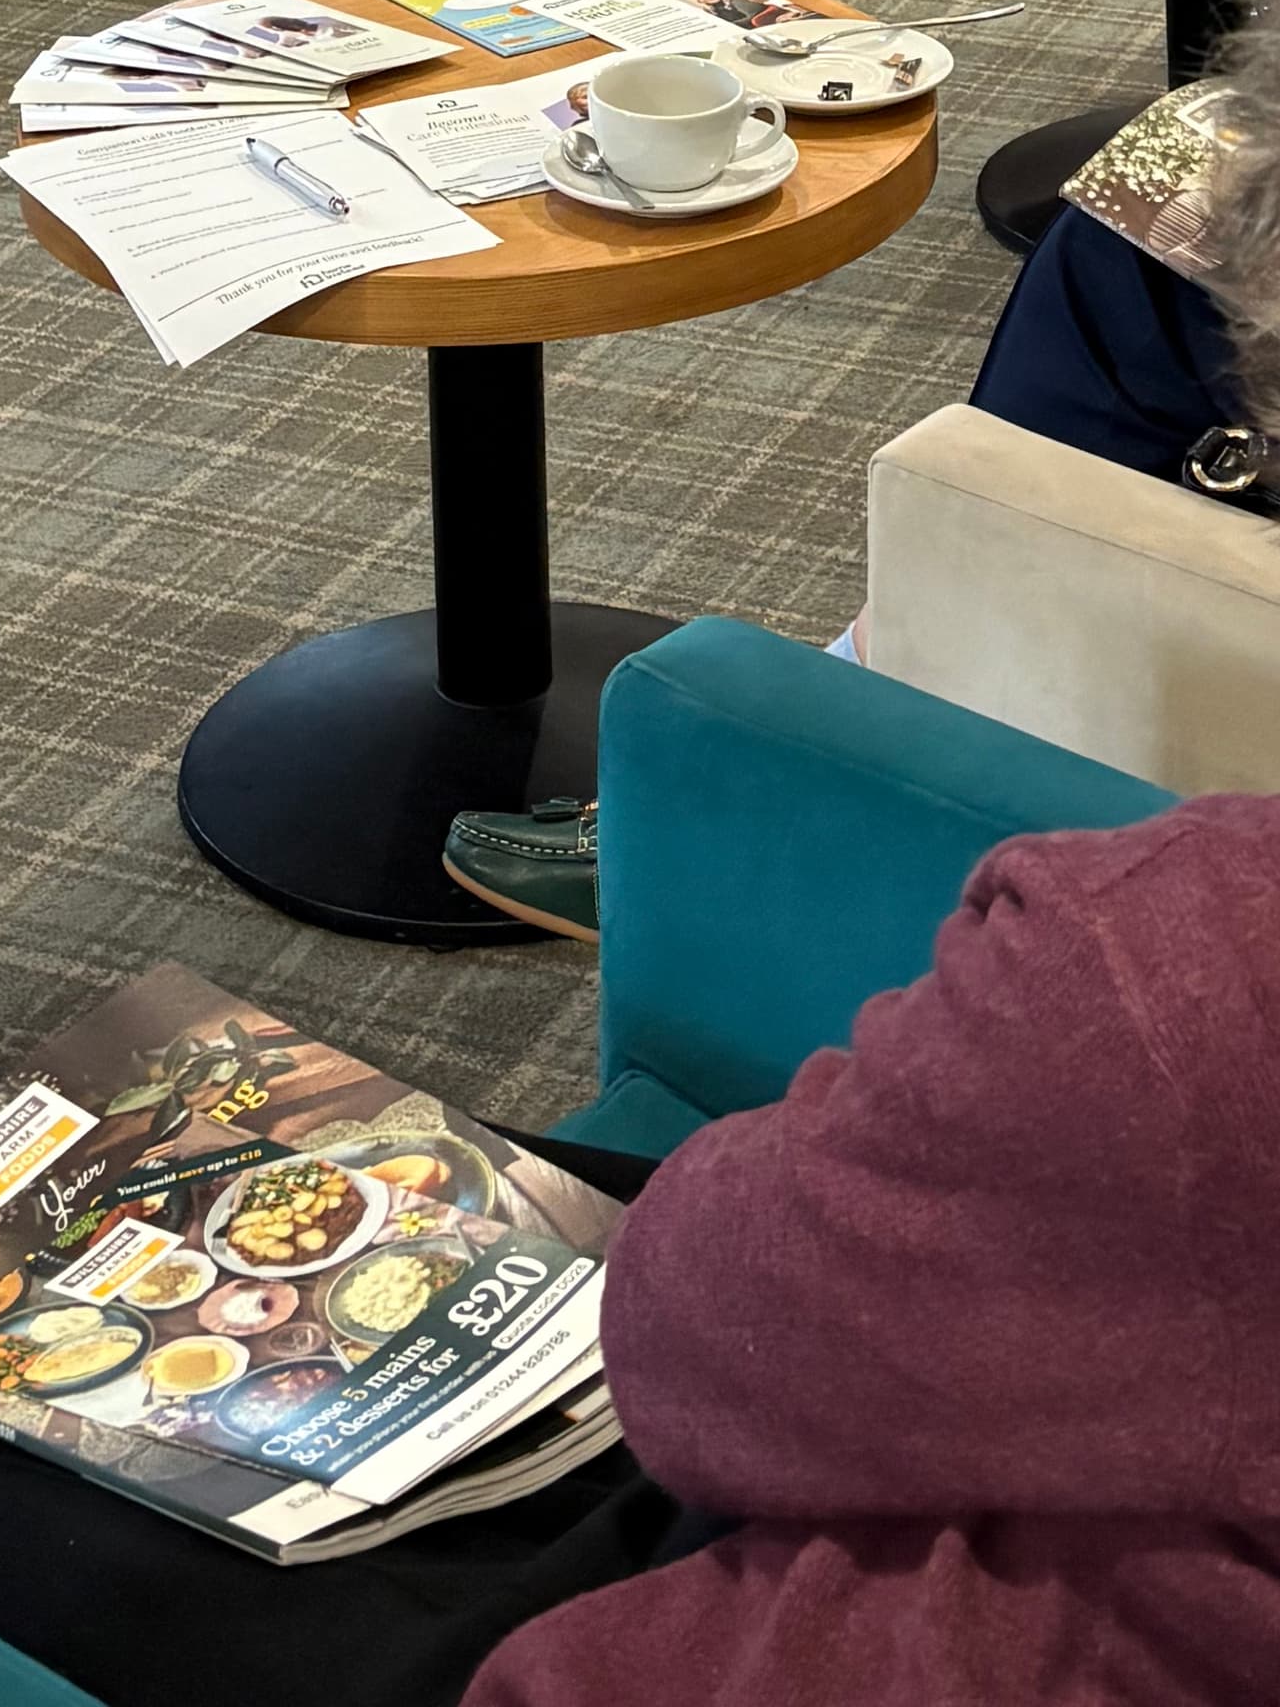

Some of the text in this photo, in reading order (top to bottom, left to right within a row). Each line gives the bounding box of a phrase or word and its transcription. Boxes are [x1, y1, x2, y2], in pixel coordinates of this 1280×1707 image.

[407, 115, 530, 141] Care Professional
[428, 114, 487, 130] Become
[216, 281, 255, 305] Thank
[256, 272, 276, 289] you
[276, 265, 294, 278] for
[295, 258, 320, 274] your
[322, 251, 349, 264] time
[0, 1132, 58, 1185] FOODS
[117, 1183, 141, 1196] You
[142, 1172, 177, 1190] could
[206, 1161, 224, 1173] up
[224, 1157, 238, 1167] to
[41, 1159, 106, 1232] Your
[261, 1400, 352, 1457] Choose
[341, 1386, 369, 1404] 5
[363, 1335, 438, 1392] mains
[290, 1445, 325, 1467] &
[314, 1434, 343, 1454] 2
[339, 1374, 431, 1438] desserts
[419, 1346, 462, 1383] for
[426, 1421, 455, 1440] Call
[454, 1410, 472, 1423] us
